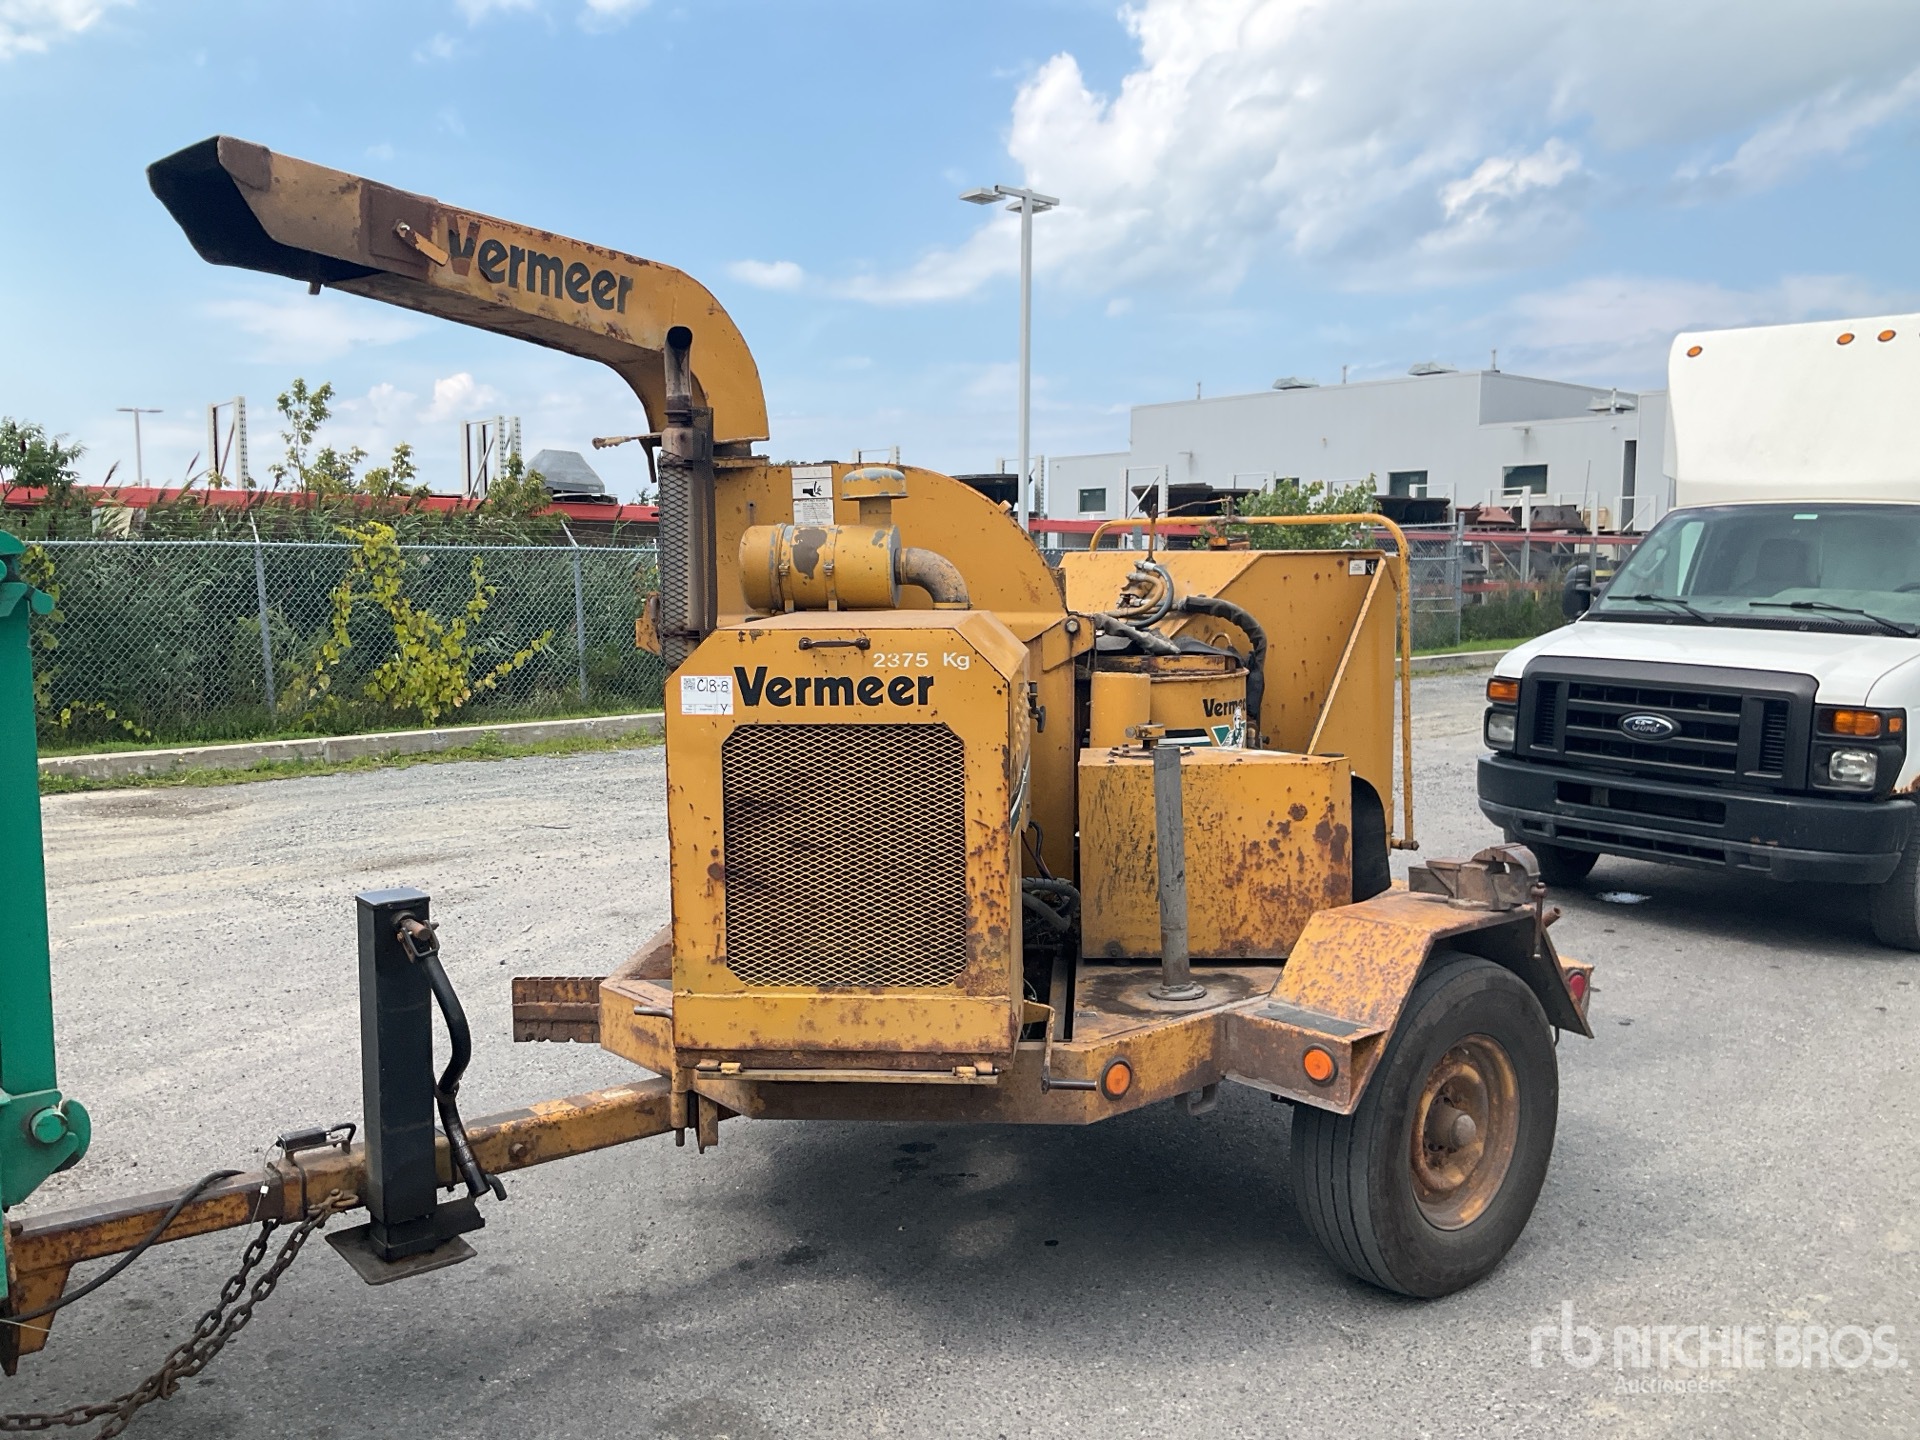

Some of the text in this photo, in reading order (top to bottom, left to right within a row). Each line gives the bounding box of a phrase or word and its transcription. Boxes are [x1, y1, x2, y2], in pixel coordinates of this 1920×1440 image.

[448, 214, 634, 315] Vermeer
[873, 652, 970, 670] 2375 Kg
[733, 666, 934, 706] Vermeer
